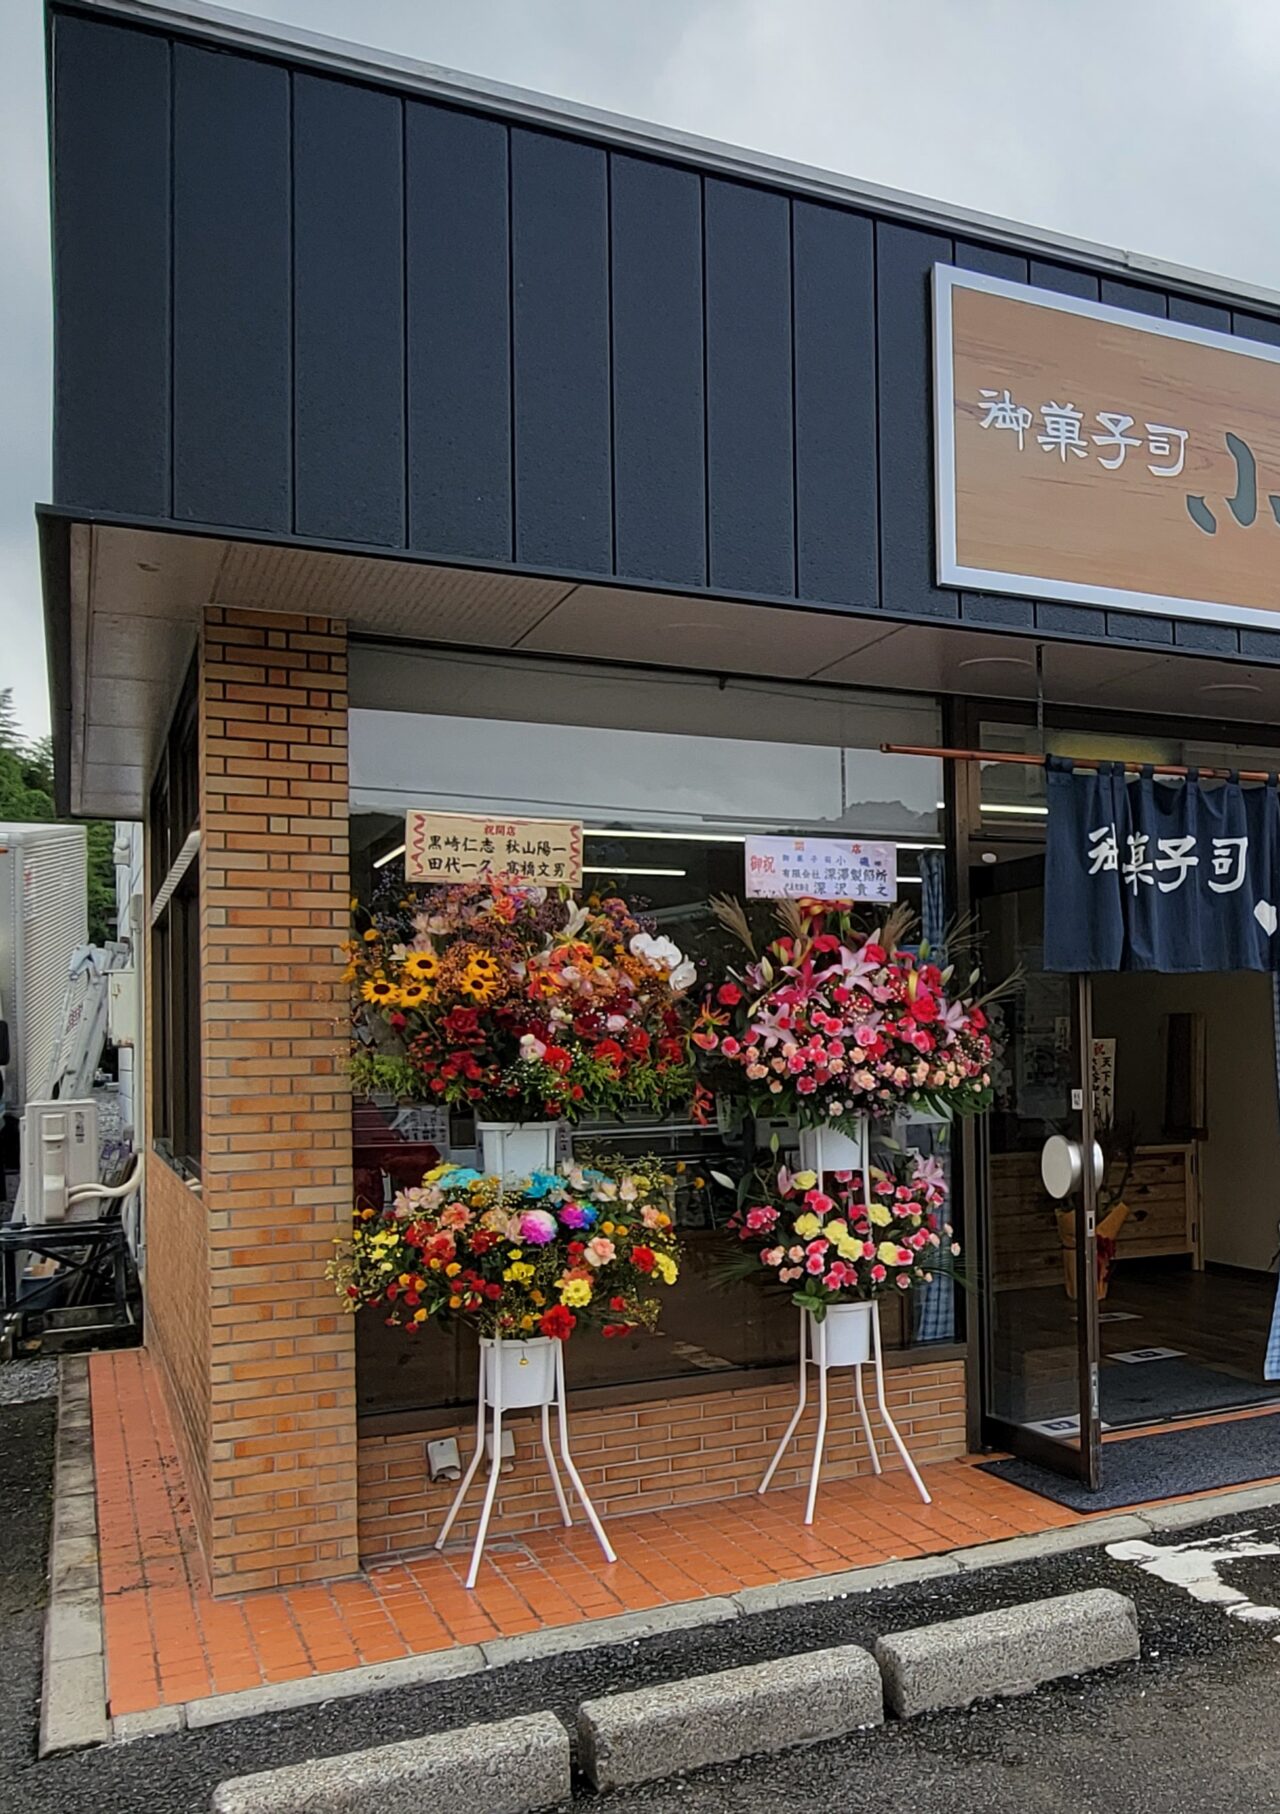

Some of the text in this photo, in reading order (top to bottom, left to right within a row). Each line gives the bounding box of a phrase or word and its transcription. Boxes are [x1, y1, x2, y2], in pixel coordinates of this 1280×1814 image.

[978, 389, 1190, 477] 御菓子司
[505, 838, 567, 857] 秋山陽一
[427, 857, 494, 875] 田代一久
